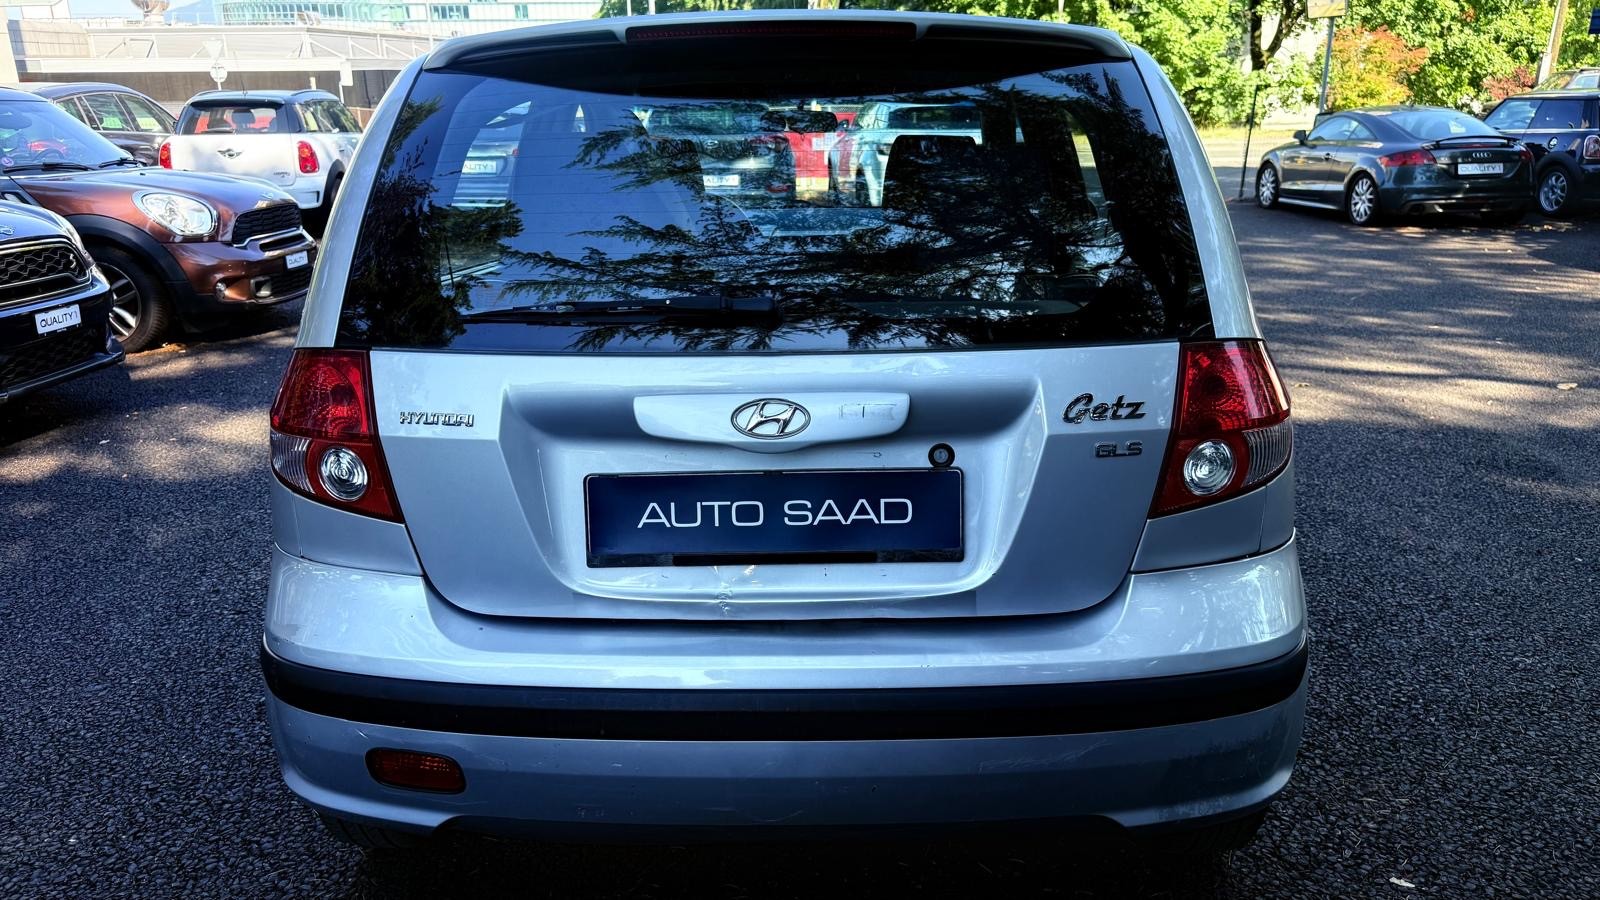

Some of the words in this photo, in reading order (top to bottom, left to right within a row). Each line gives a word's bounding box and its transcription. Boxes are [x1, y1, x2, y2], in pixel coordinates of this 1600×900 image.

[40, 311, 73, 328] QUALITY
[1063, 393, 1146, 424] Getz
[400, 411, 474, 427] HYUNDAI
[1094, 440, 1143, 457] GLS
[637, 500, 764, 528] AUTO
[783, 498, 913, 526] SAAD
